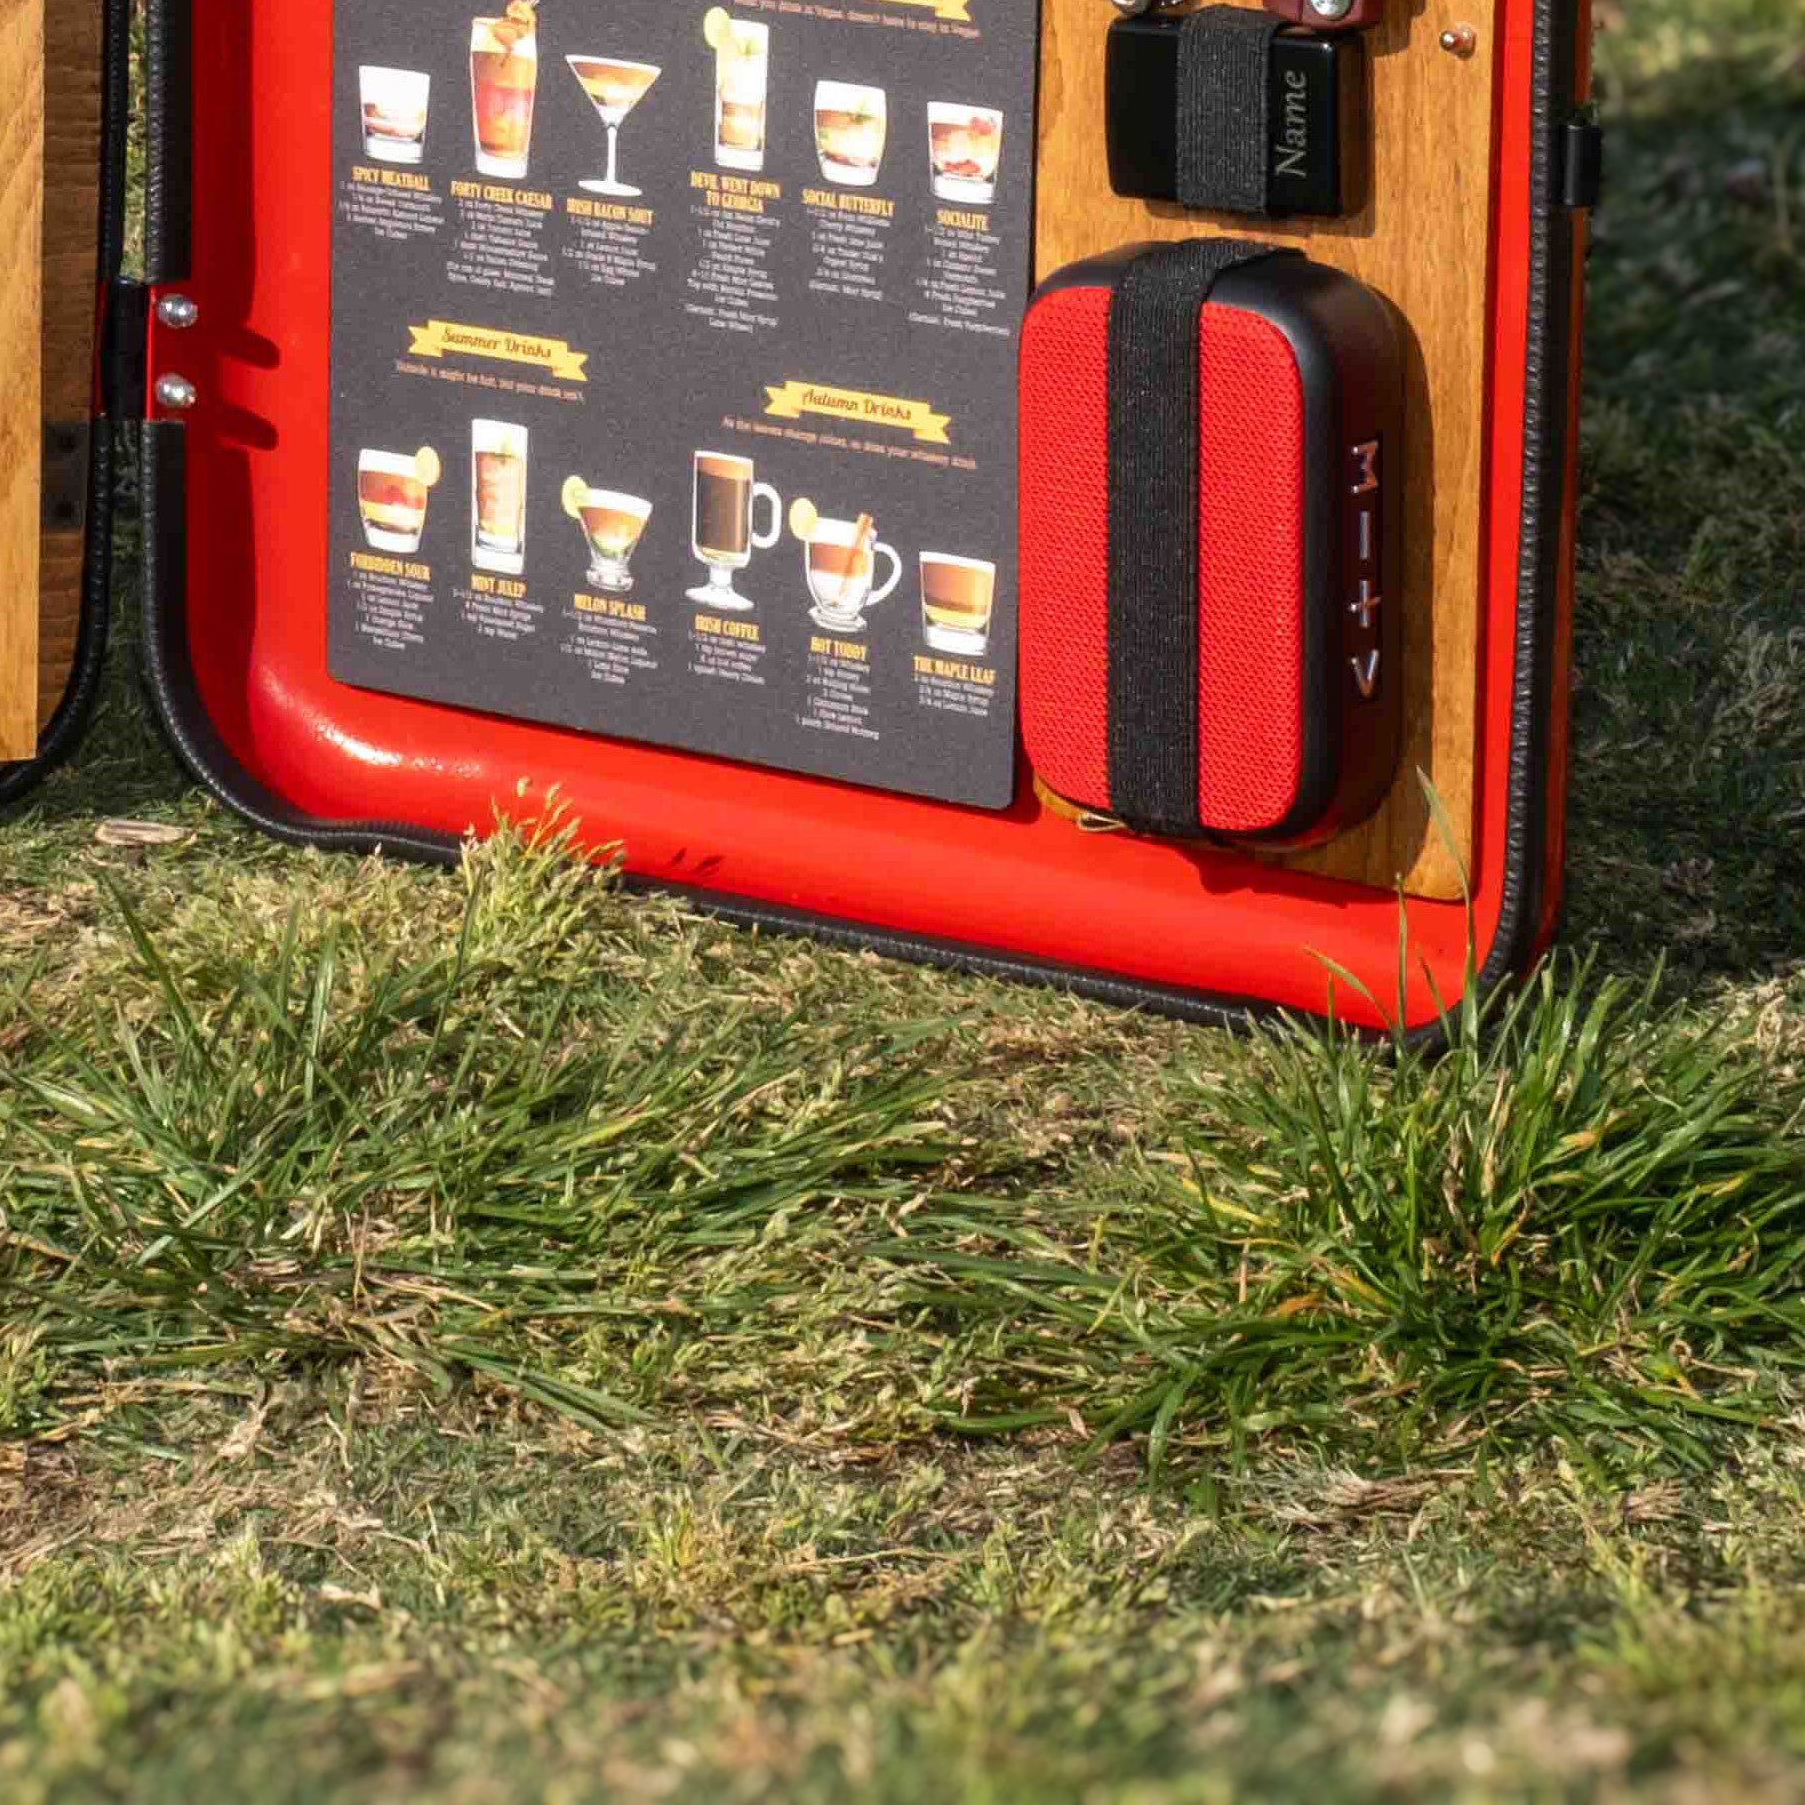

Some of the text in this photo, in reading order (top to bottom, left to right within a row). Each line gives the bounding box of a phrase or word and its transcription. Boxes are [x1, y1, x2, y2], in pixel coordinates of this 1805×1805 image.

[1275, 70, 1307, 177] Name
[444, 328, 552, 359] Summer Drinks
[802, 388, 912, 421] Autumn Drinks
